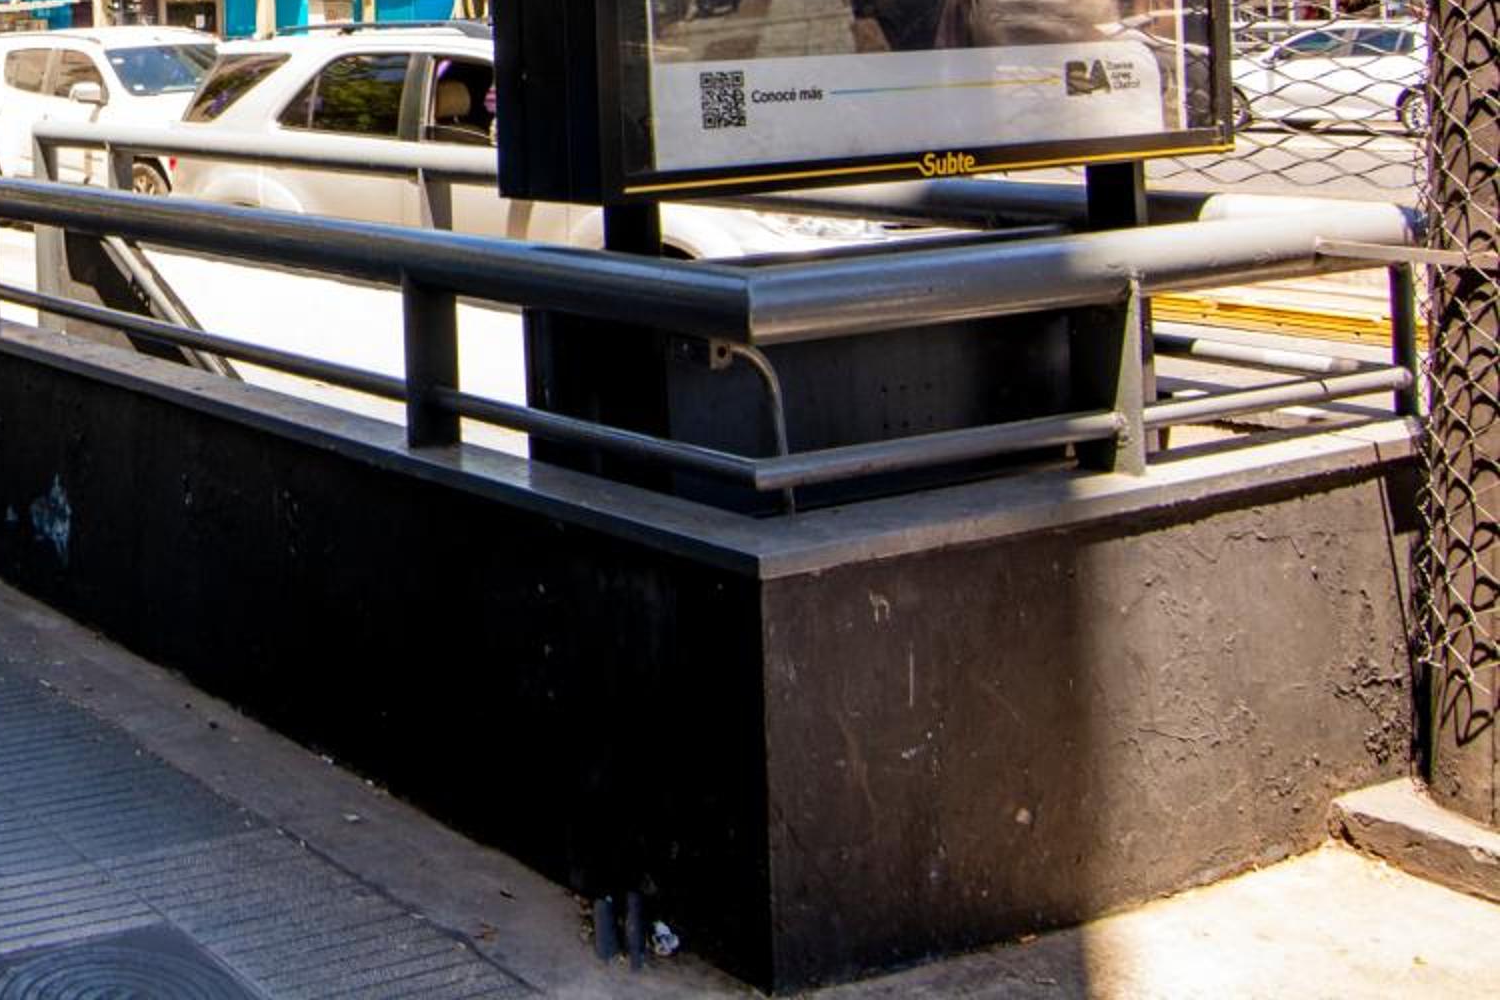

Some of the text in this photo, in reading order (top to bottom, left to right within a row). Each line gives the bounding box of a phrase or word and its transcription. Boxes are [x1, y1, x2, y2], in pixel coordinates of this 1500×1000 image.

[751, 86, 823, 103] Conocé más
[920, 151, 976, 177] Subte
